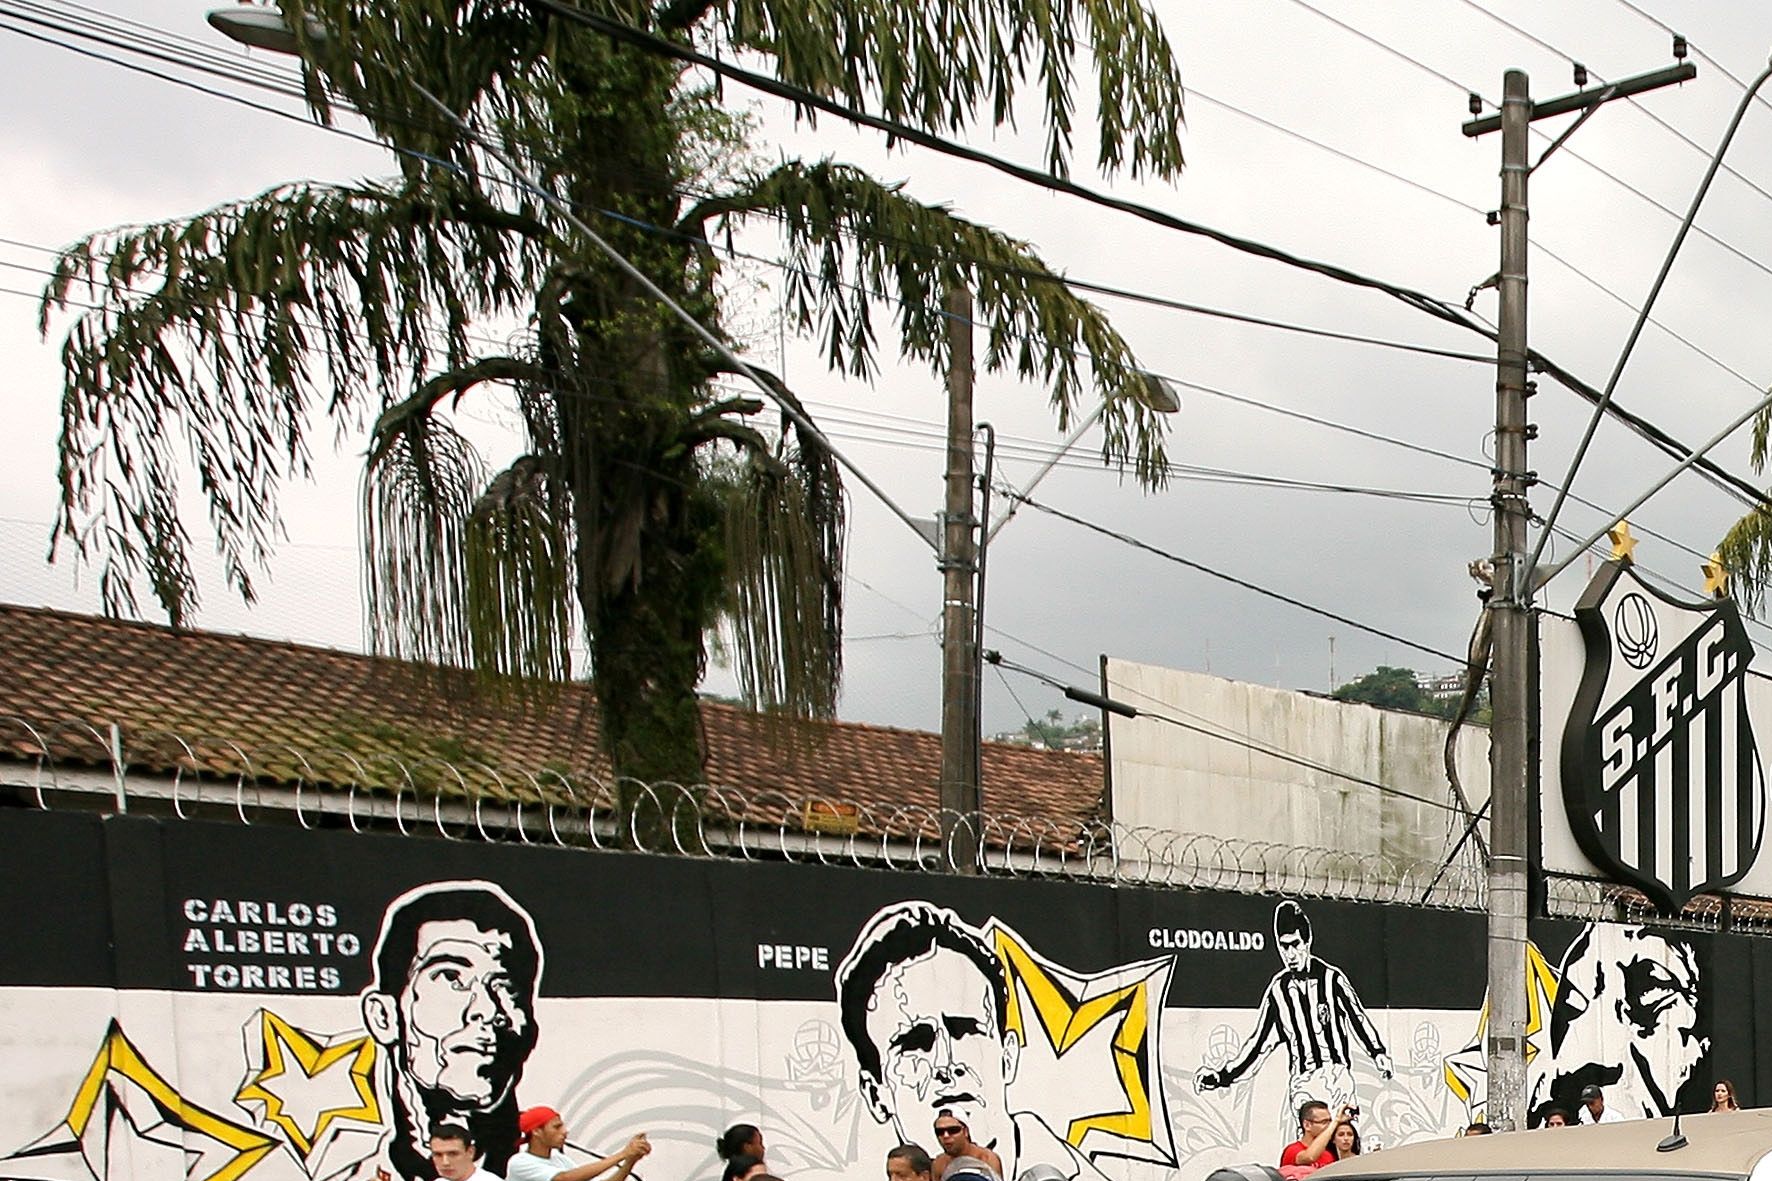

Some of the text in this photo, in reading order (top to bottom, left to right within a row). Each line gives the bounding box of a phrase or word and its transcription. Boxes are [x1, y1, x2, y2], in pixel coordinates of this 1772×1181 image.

[1601, 619, 1738, 792] S.F.C.
[183, 898, 338, 928] CARLOS
[183, 928, 361, 957] ALBERTO
[1148, 928, 1265, 951] CLODOALDO
[757, 944, 830, 971] PEPE
[186, 964, 342, 989] TORRES
